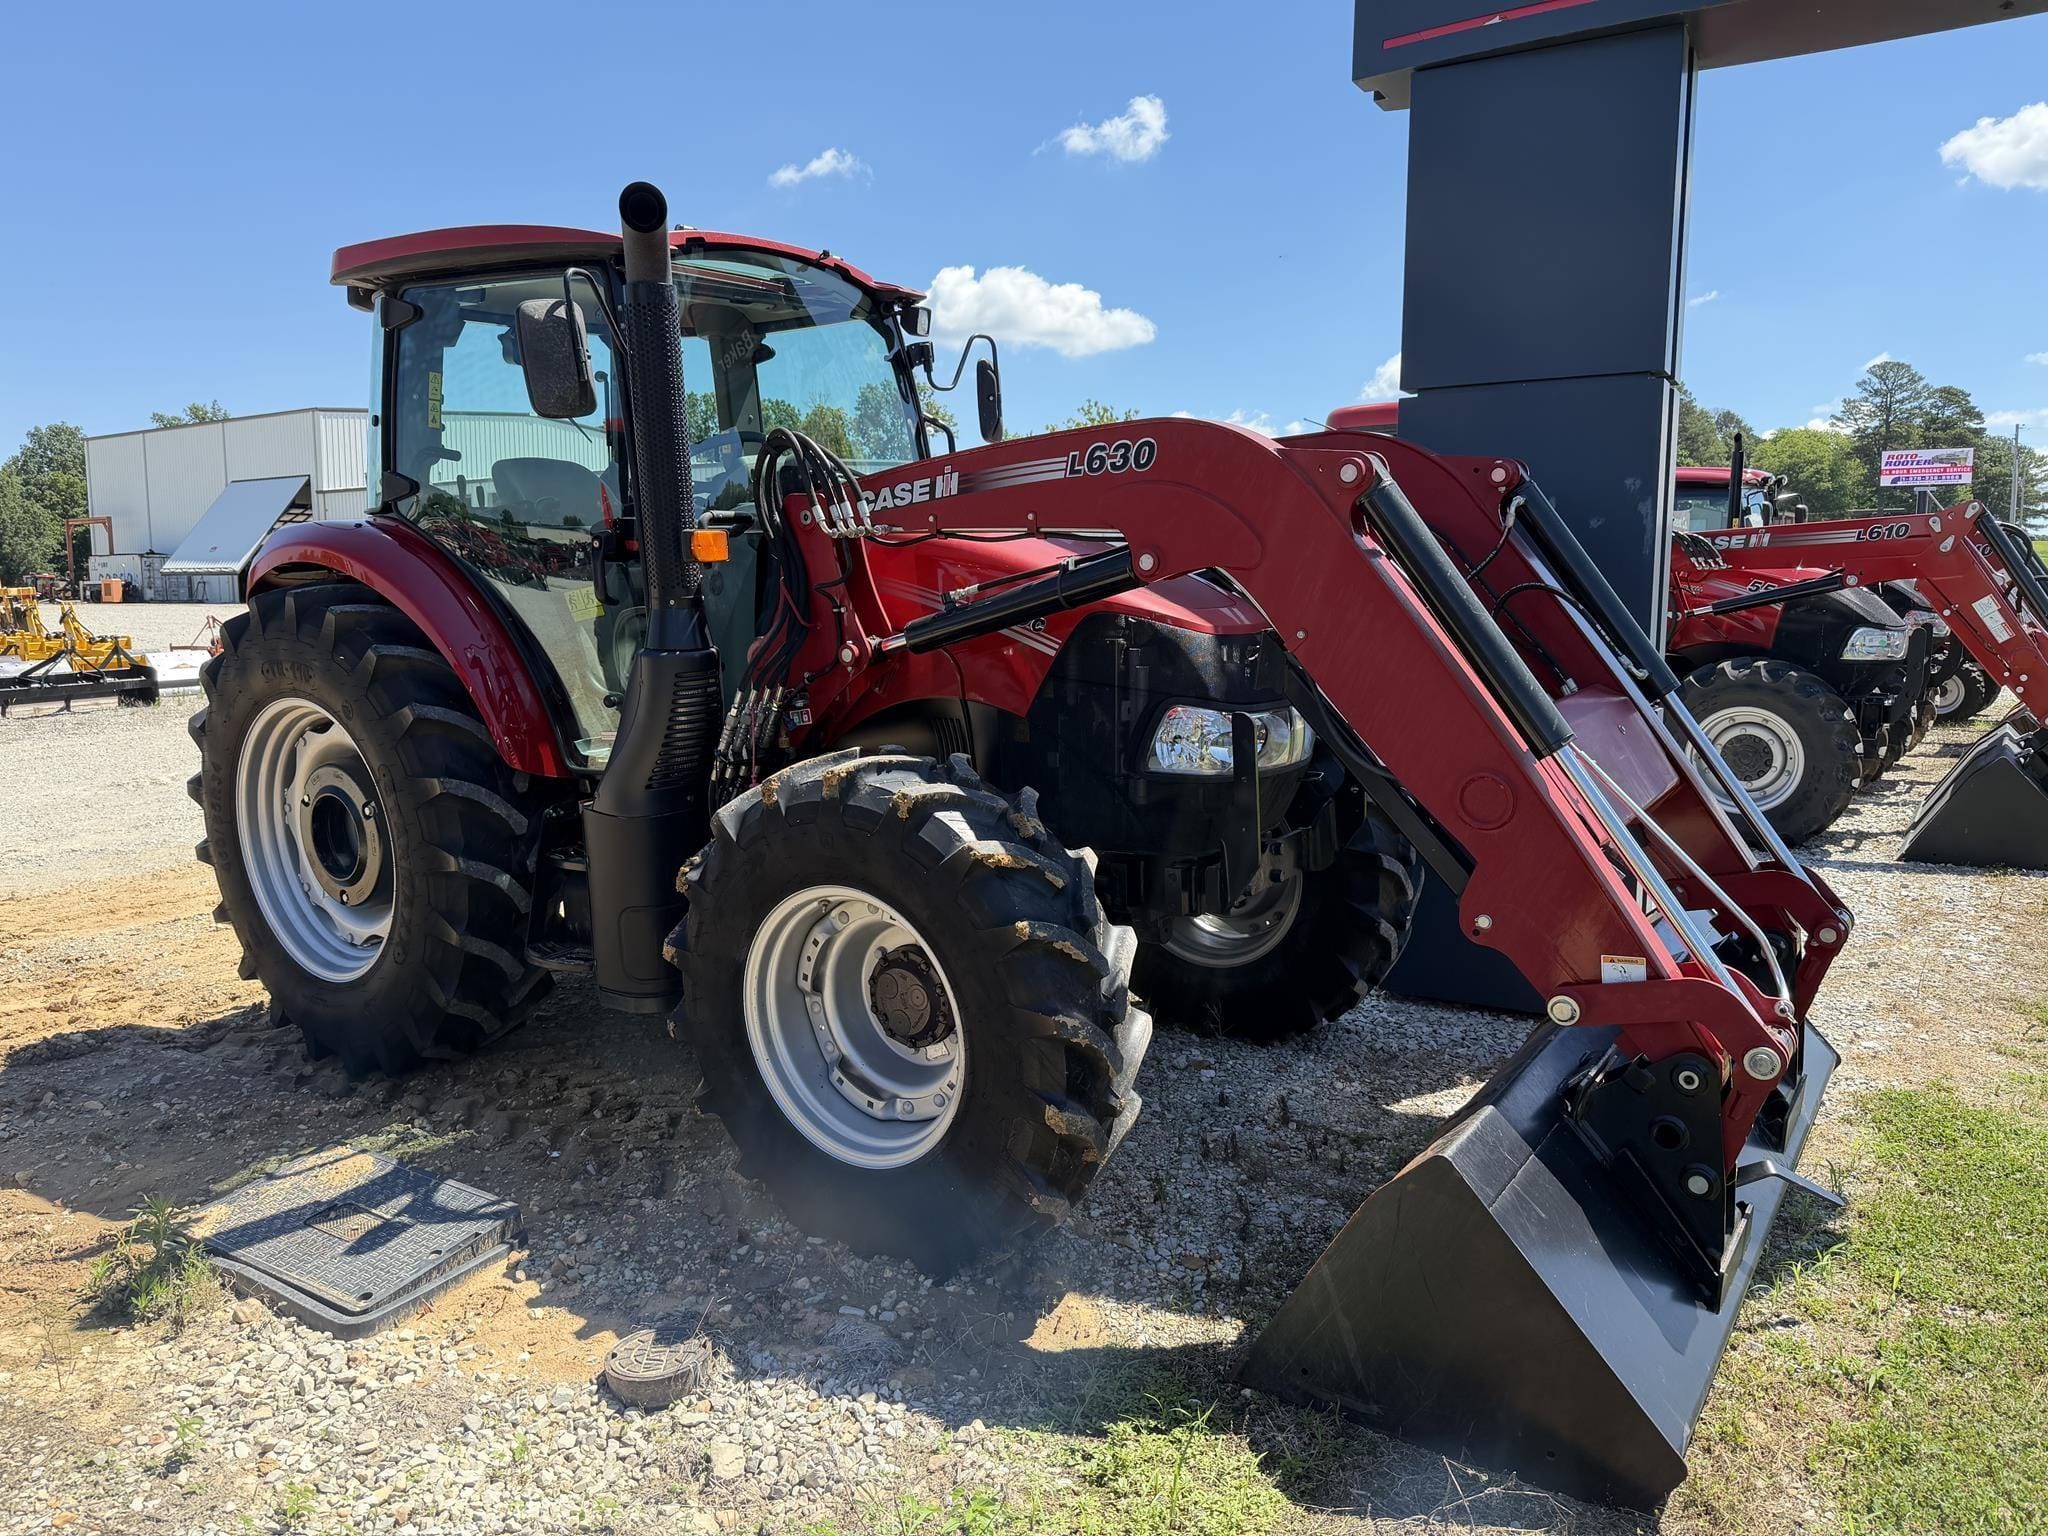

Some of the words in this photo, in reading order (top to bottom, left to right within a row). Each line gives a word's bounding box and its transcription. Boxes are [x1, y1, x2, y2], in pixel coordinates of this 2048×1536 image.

[1066, 437, 1158, 478] L630
[859, 477, 931, 513] CASE
[1706, 534, 1747, 551] SE
[1855, 522, 1910, 542] L610
